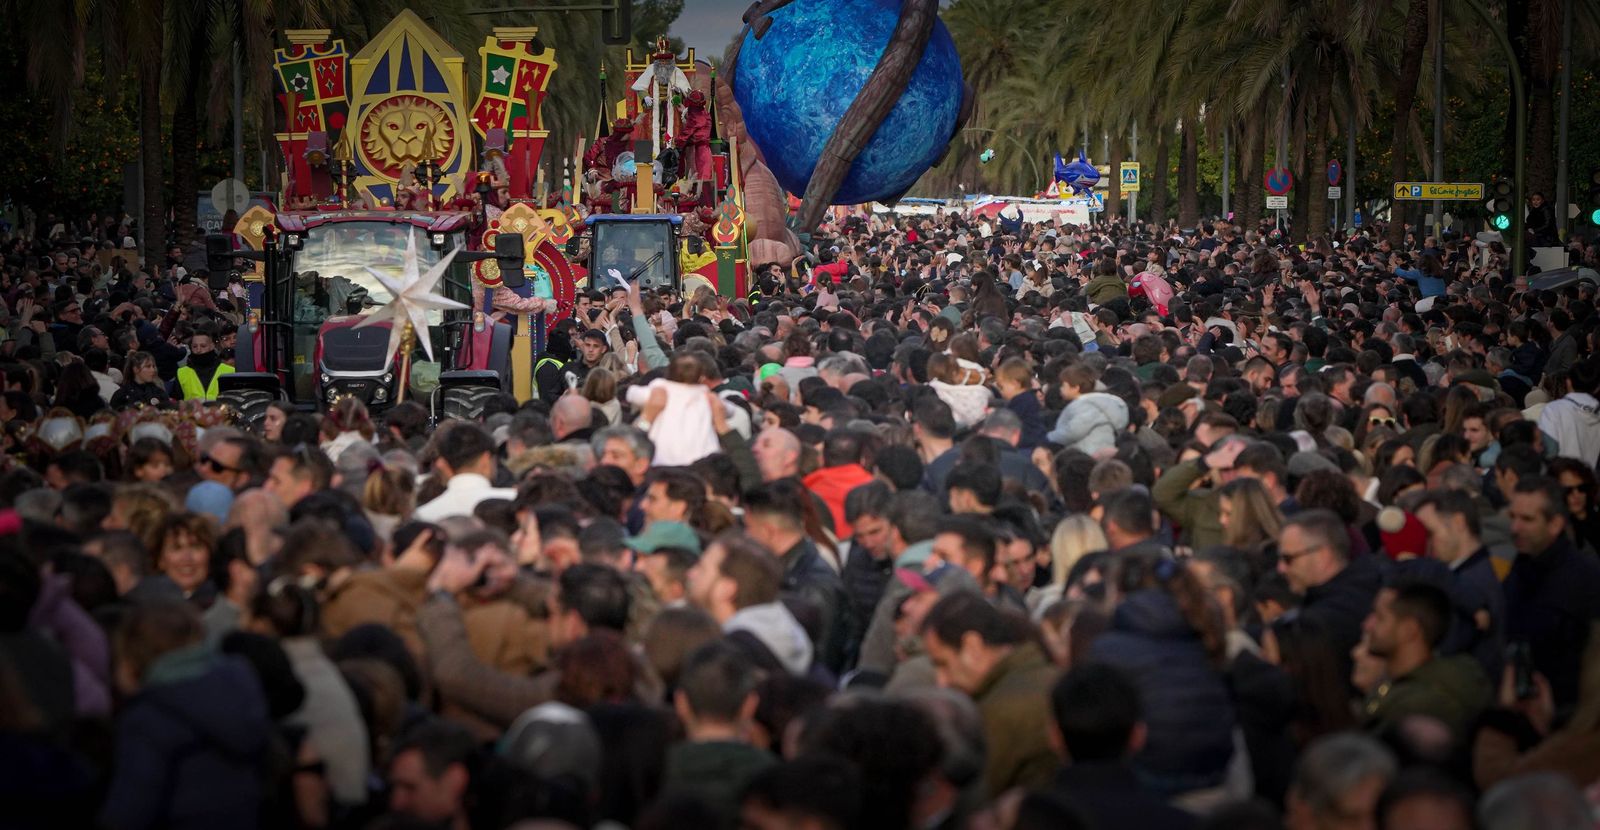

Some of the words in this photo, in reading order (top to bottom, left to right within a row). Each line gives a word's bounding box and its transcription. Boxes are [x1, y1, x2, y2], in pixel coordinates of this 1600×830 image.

[1412, 186, 1420, 195] P
[1429, 186, 1437, 194] El
[1437, 186, 1454, 195] Corte
